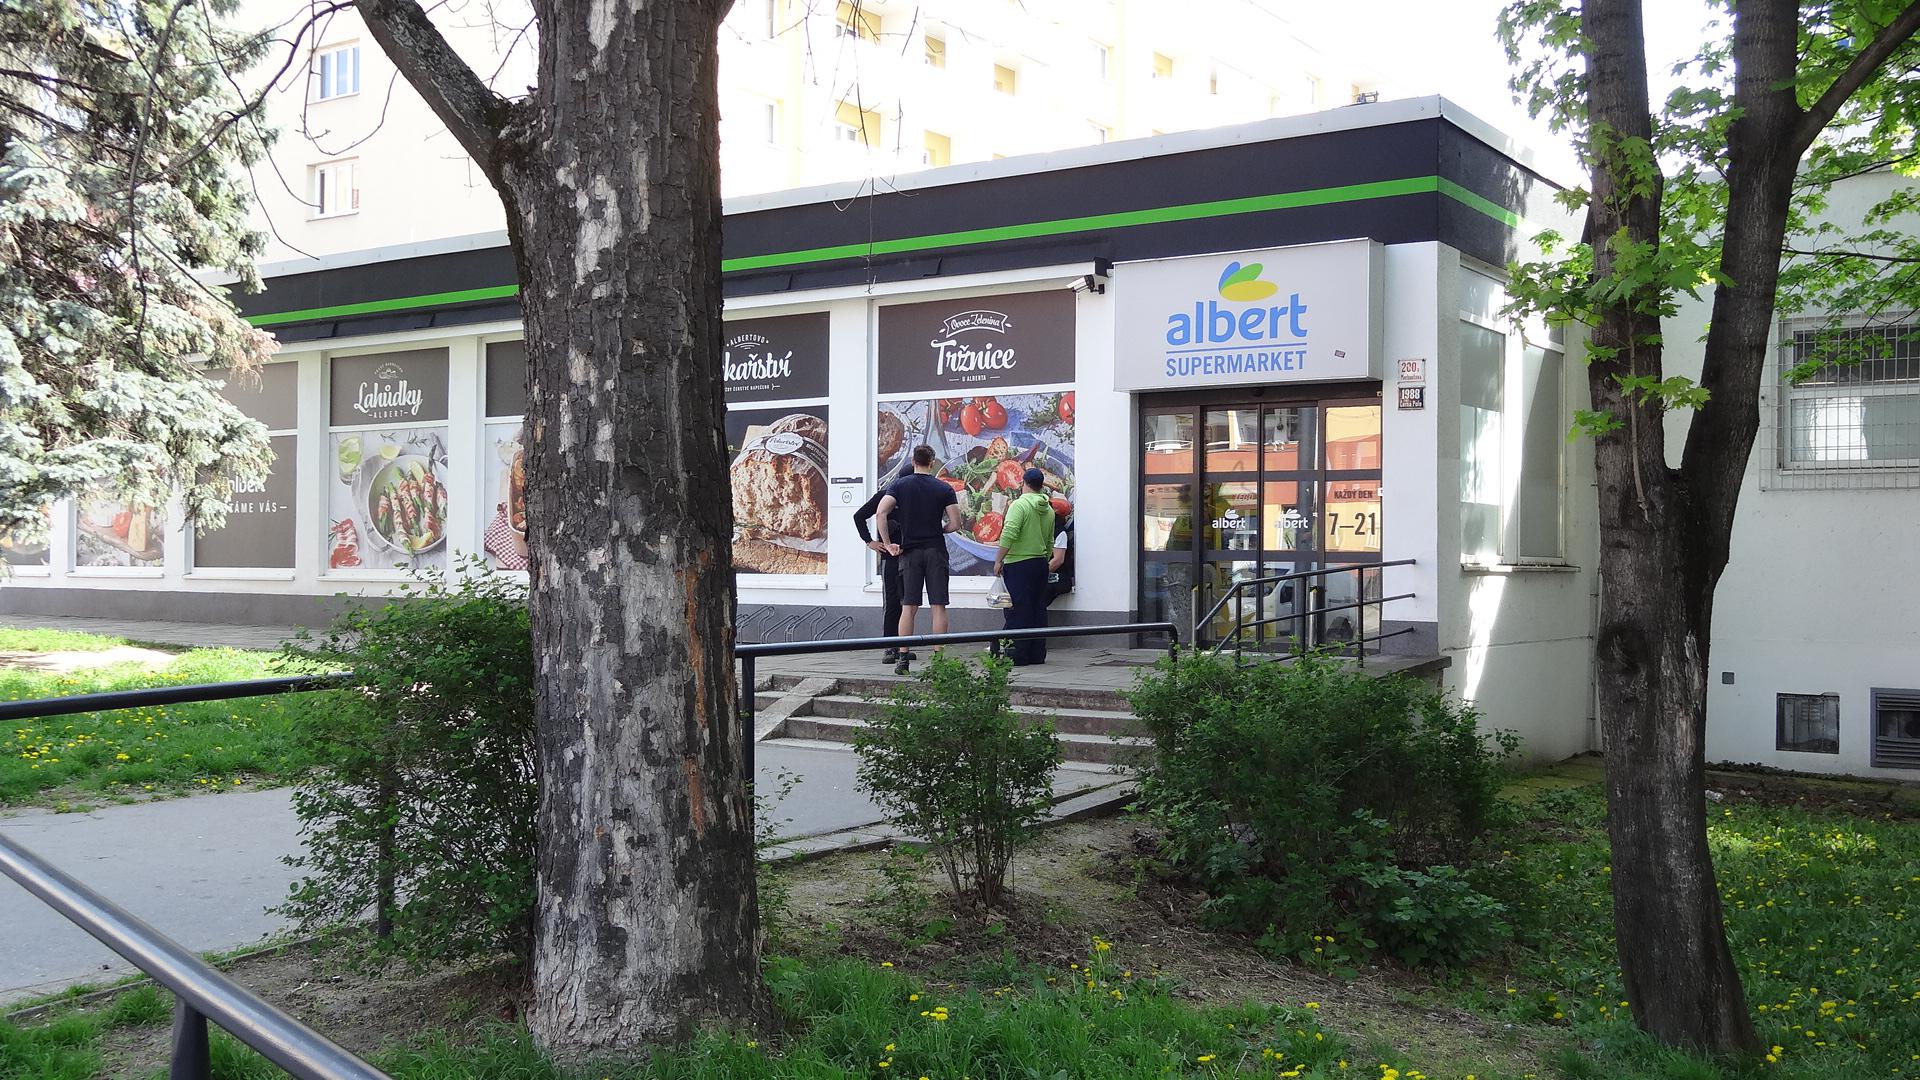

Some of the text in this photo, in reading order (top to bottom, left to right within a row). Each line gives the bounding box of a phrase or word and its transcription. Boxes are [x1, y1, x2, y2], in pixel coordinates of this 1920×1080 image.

[950, 314, 1000, 330] Ovoce Zelenina
[1166, 293, 1308, 346] albert
[730, 334, 766, 346] ALBERTOVO
[930, 339, 1017, 376] Tržnice
[1166, 350, 1307, 377] SUPERMARKET
[723, 350, 793, 382] kařství
[353, 380, 424, 416] Lahůdky
[1401, 388, 1421, 400] 1988
[373, 410, 403, 419] ALBERT
[228, 500, 277, 513] TÁME VÁS
[1212, 517, 1246, 529] albert
[1274, 517, 1309, 529] albert
